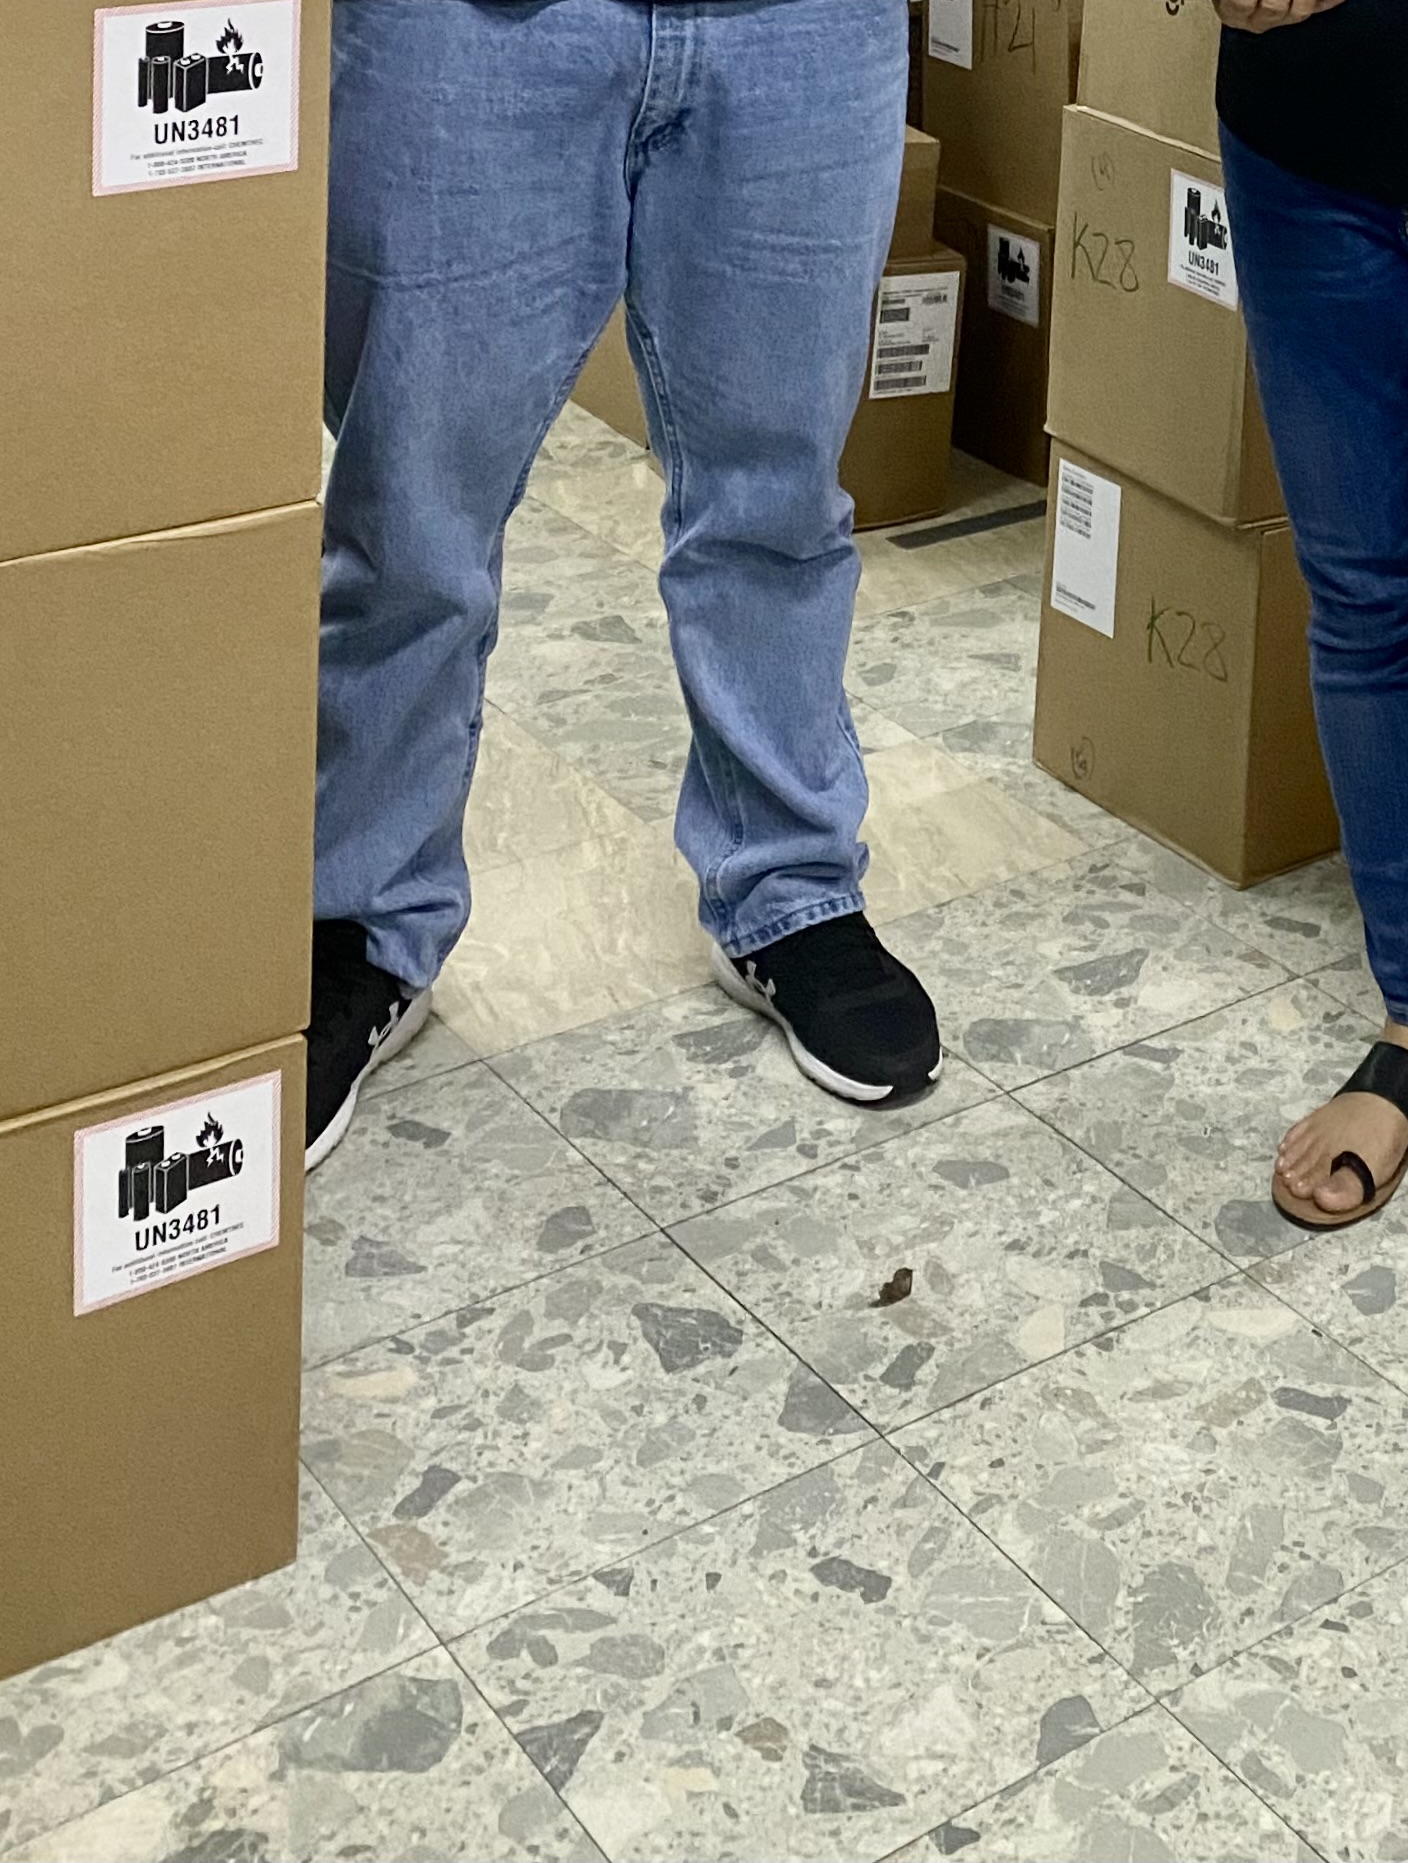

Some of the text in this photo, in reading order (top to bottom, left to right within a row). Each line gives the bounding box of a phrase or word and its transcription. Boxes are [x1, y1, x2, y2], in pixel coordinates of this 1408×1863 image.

[154, 115, 240, 144] UN3481
[1071, 210, 1139, 292] K28
[1188, 250, 1219, 276] UN3481
[1147, 595, 1228, 682] K28
[135, 1204, 220, 1251] UN3481
